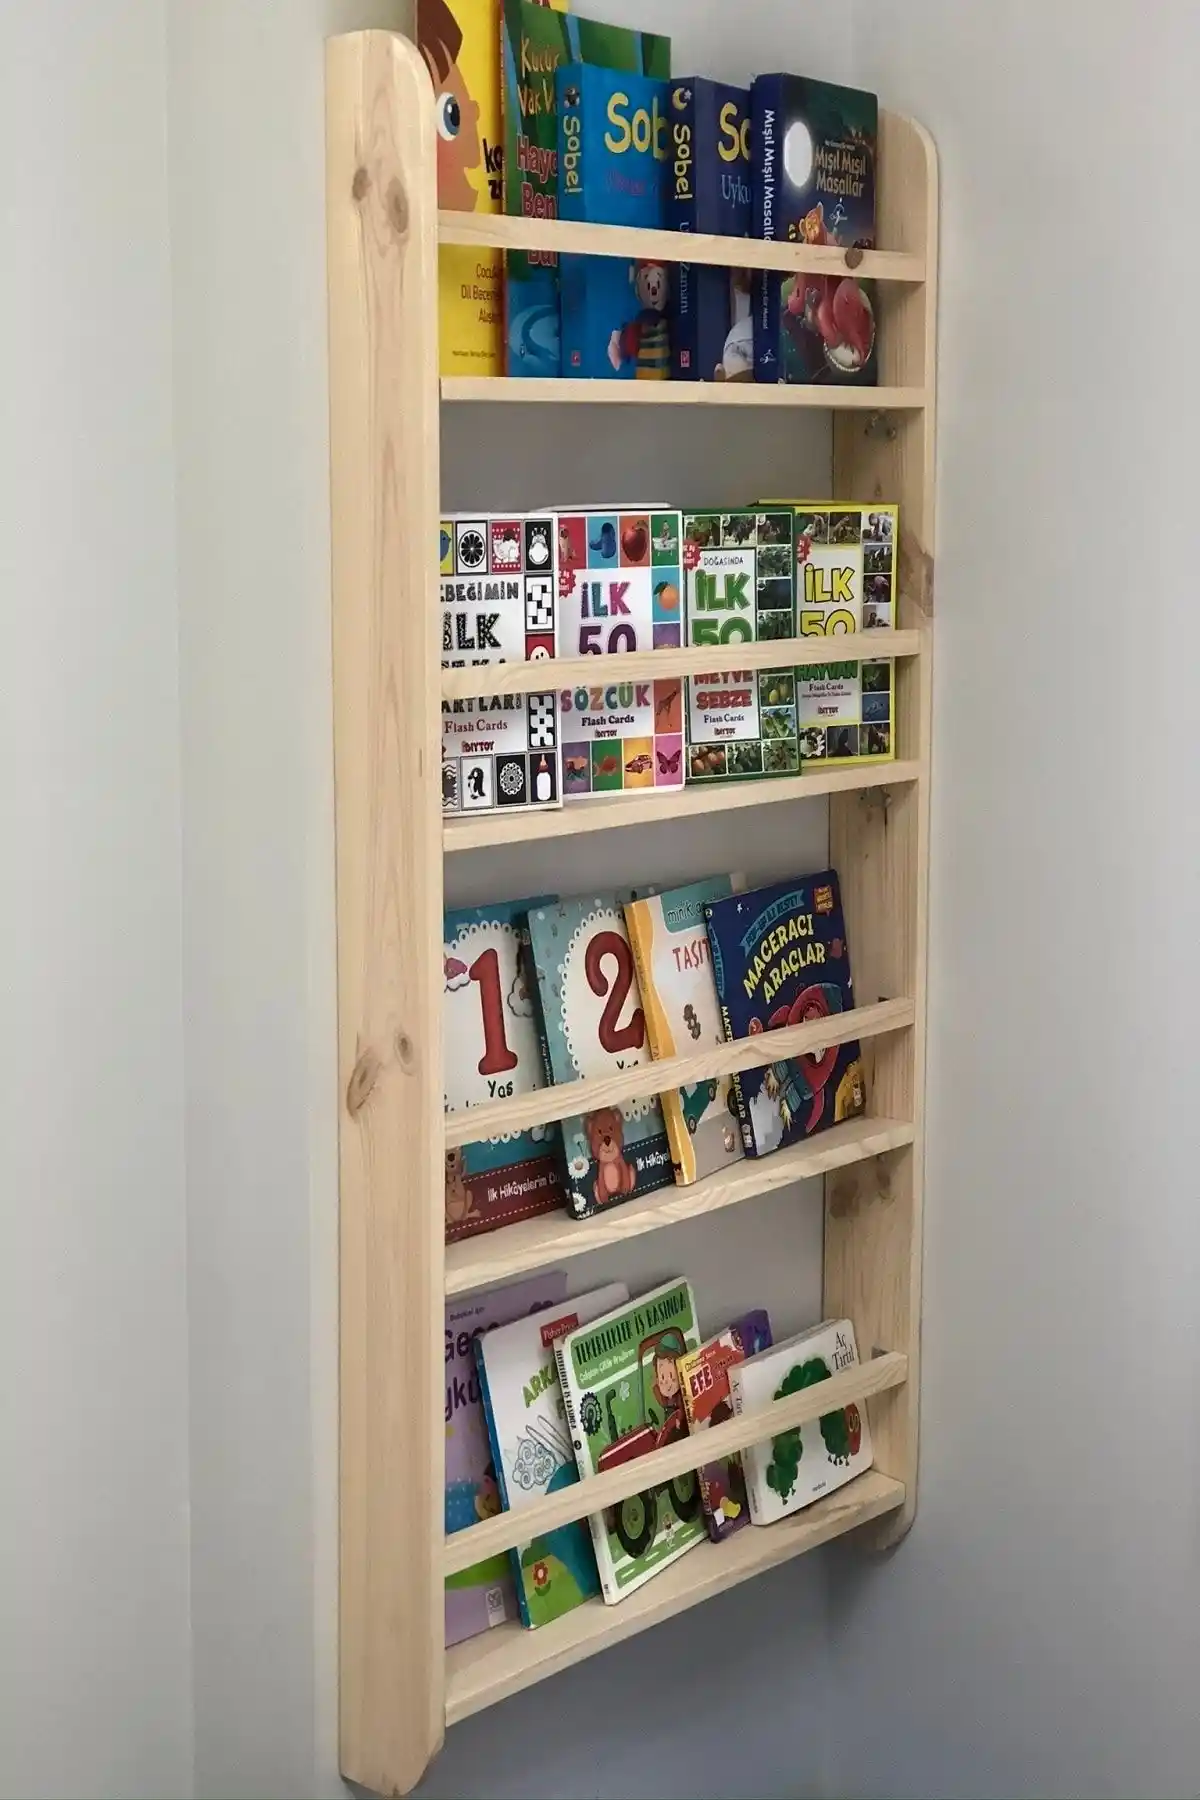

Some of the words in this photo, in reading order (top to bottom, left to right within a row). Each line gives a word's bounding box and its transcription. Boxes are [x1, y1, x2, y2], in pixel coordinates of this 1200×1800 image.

[762, 109, 776, 145] Mışıl
[762, 148, 776, 183] Mışıl
[816, 170, 865, 197] Masallar
[440, 581, 519, 602] BEĞİMİN
[695, 568, 751, 611] İLK
[804, 563, 855, 603] İLK
[581, 582, 631, 618] İLK
[692, 616, 753, 646] 50
[800, 609, 856, 637] 50
[578, 624, 637, 655] 50
[560, 682, 651, 712] SÖZCÜK
[696, 688, 753, 710] SEBZE
[826, 682, 844, 691] Cards
[444, 720, 474, 734] Flash
[476, 718, 508, 731] Cards
[581, 716, 607, 727] Flash
[608, 714, 635, 725] Cards
[703, 714, 723, 724] Flash
[724, 713, 745, 723] Cards
[743, 913, 815, 1000] MACERACI
[761, 942, 826, 1005] ARAÇLAR
[585, 931, 645, 1053] 2
[469, 948, 518, 1075] 1
[646, 1291, 688, 1330] BAŞINDA
[836, 1331, 847, 1350] Aç
[832, 1344, 855, 1371] Tırtıl
